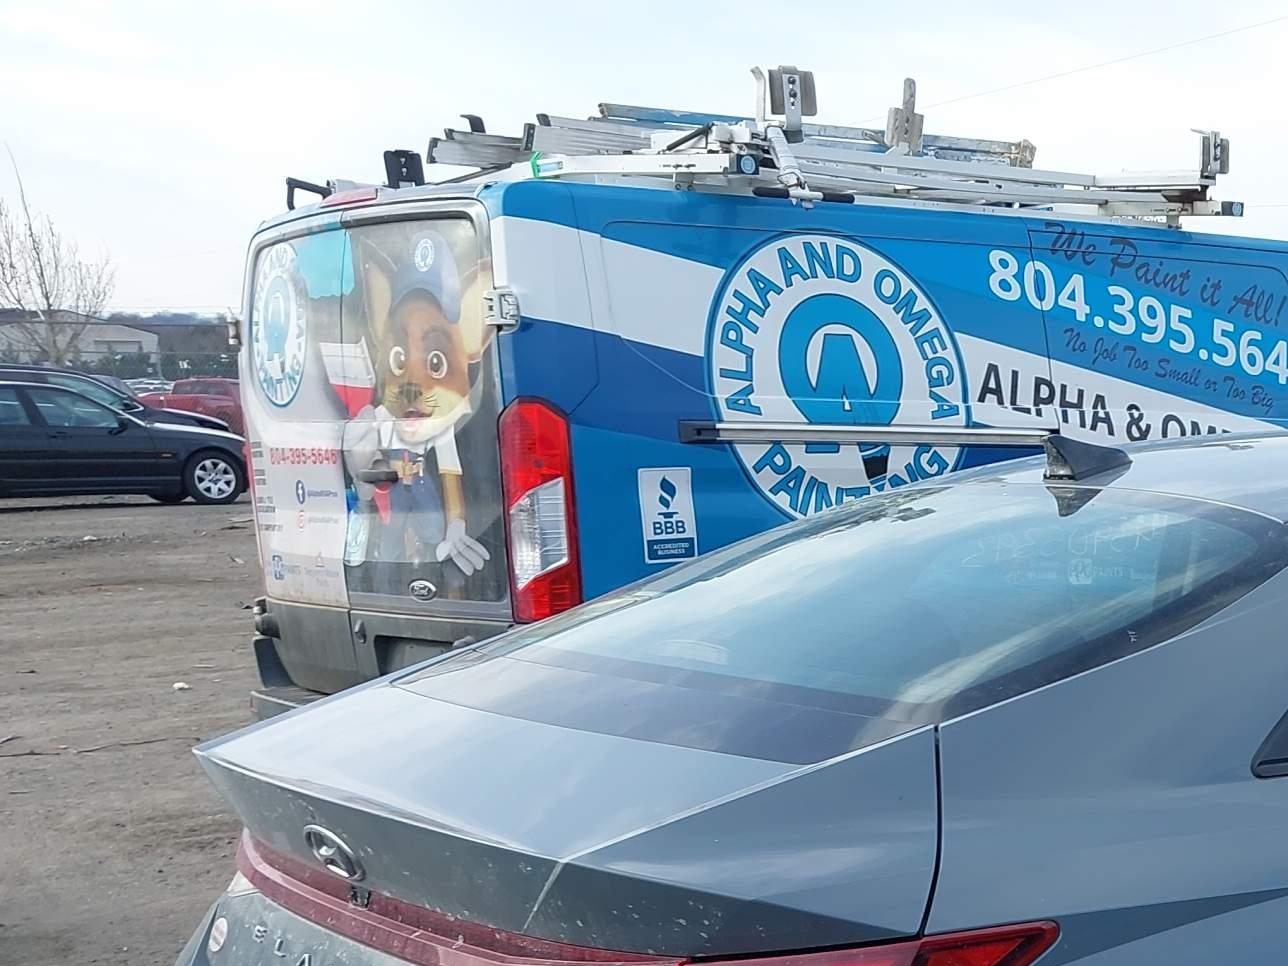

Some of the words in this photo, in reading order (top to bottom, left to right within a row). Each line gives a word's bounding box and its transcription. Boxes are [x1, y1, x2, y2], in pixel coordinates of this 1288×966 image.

[1045, 222, 1096, 265] We
[1110, 237, 1192, 296] Paint
[1200, 277, 1222, 306] it
[1228, 284, 1287, 327] All!
[719, 268, 784, 416] ALPHA
[777, 242, 862, 288] AND
[874, 269, 960, 420] OMEGA
[1064, 328, 1087, 352] No
[1092, 337, 1118, 366] Job
[1124, 346, 1149, 372] Too
[1155, 359, 1201, 388] Small
[1223, 375, 1247, 401] Too
[1250, 386, 1275, 415] Big
[977, 362, 1116, 436] ALPHA
[1126, 403, 1151, 441] &
[652, 520, 687, 536] BBB
